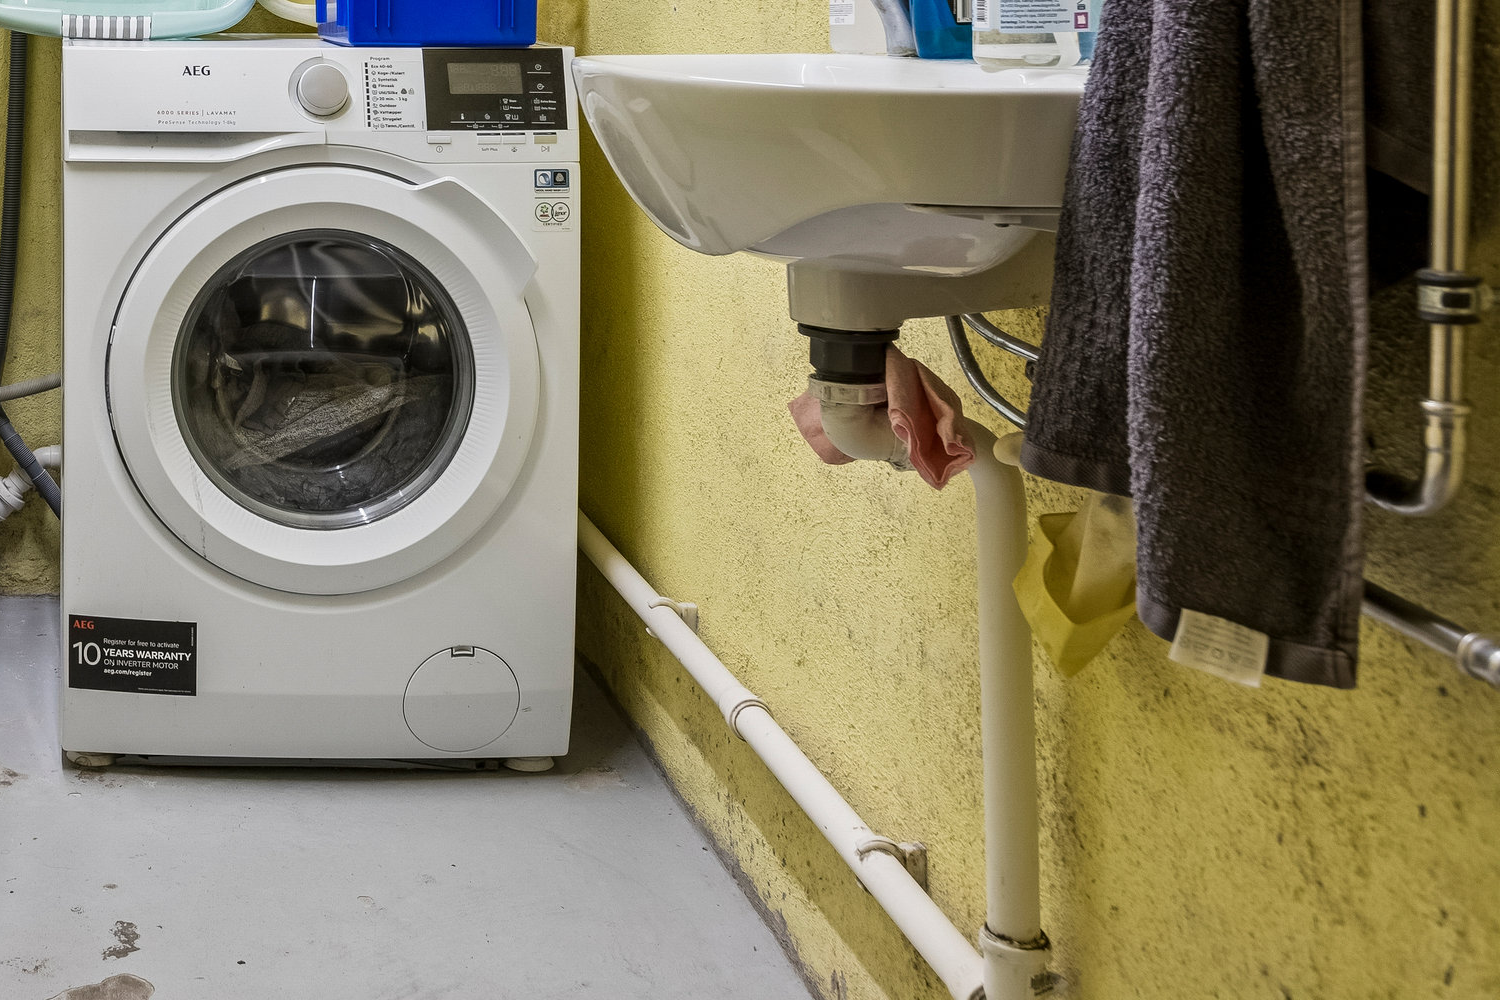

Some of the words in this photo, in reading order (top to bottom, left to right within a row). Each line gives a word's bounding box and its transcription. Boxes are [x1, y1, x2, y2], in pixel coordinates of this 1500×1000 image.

[182, 65, 211, 76] AEG
[73, 620, 95, 629] AEG
[72, 642, 101, 666] 10
[103, 648, 134, 658] YEARS
[136, 650, 192, 661] WARRANTY
[104, 668, 152, 676] aeg.com/register
